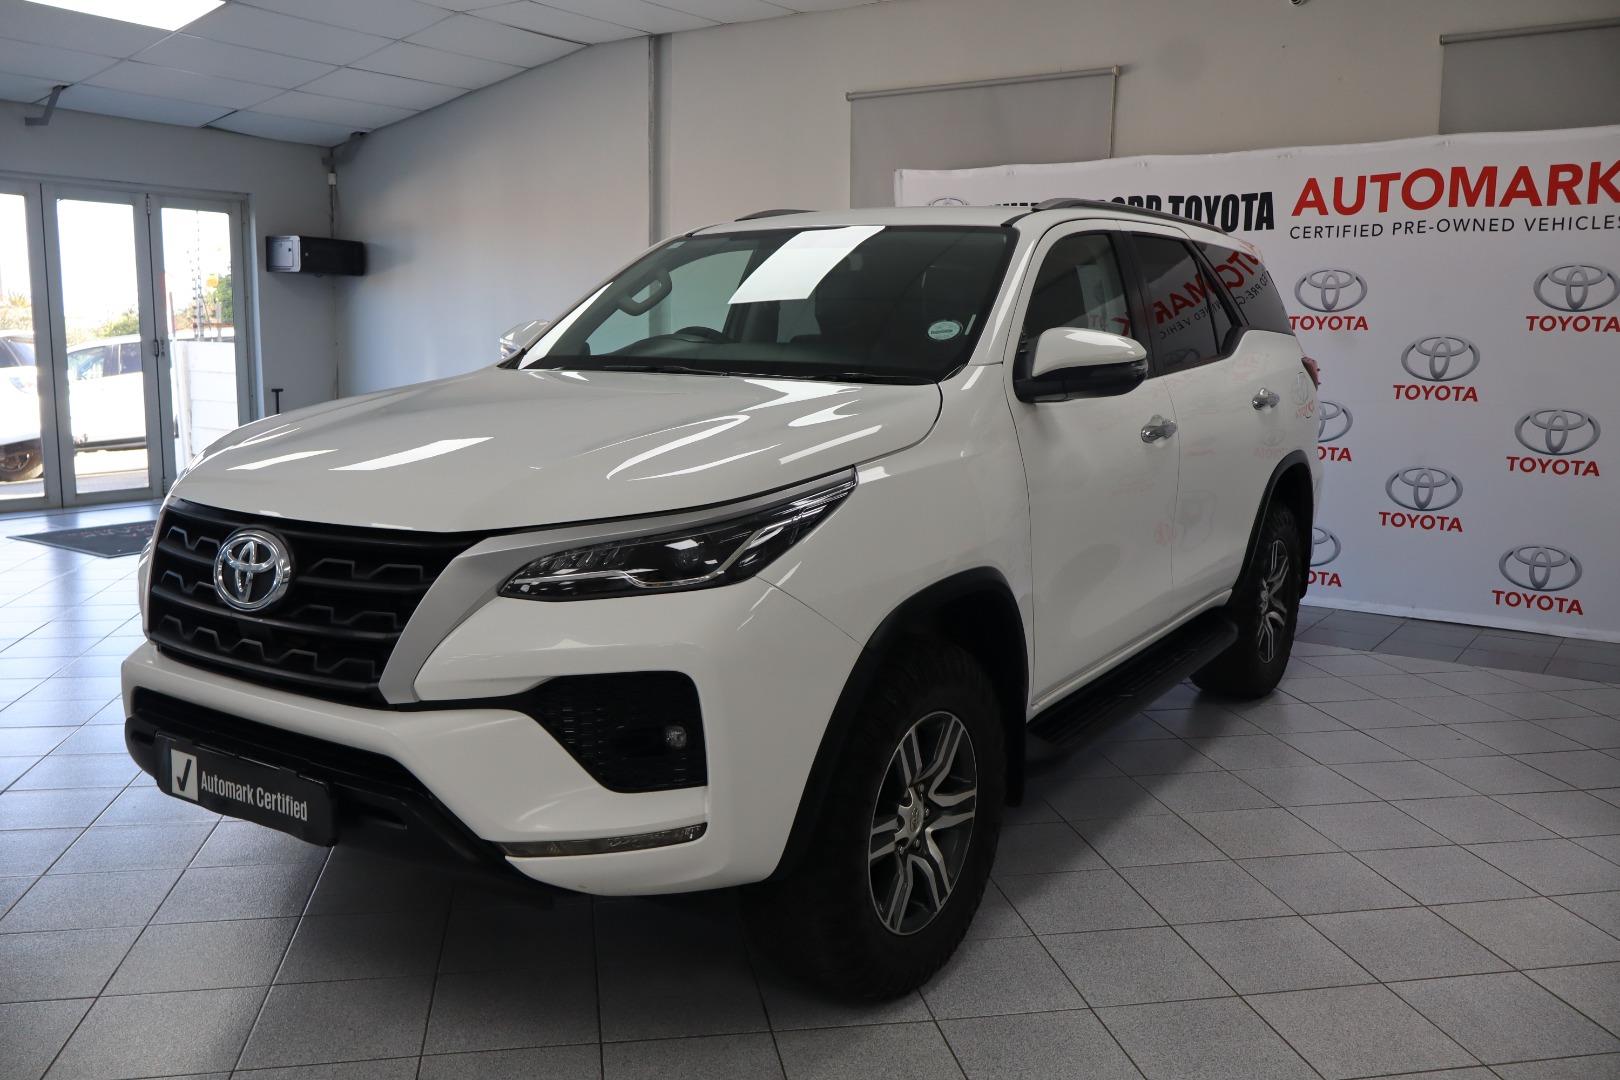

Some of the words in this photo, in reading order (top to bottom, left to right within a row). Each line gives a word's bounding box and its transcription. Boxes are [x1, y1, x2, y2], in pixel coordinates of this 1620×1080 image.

[1291, 160, 1620, 217] AUTOMARK
[1289, 223, 1384, 240] CERTIFIED
[1392, 217, 1515, 235] PRE-OWNED
[1524, 214, 1620, 232] VEHICLE
[1289, 315, 1369, 331] TOYOTA
[1526, 315, 1620, 333] TOYOTA
[1393, 384, 1479, 402] TOYOTA
[1317, 446, 1352, 462] OTA
[1506, 456, 1600, 477] TOYOTA
[1379, 511, 1463, 533] TOYOTA
[1308, 570, 1342, 587] OTA
[1492, 590, 1584, 615] TOYOTA
[201, 770, 255, 807] Automark
[256, 786, 308, 822] Certified
